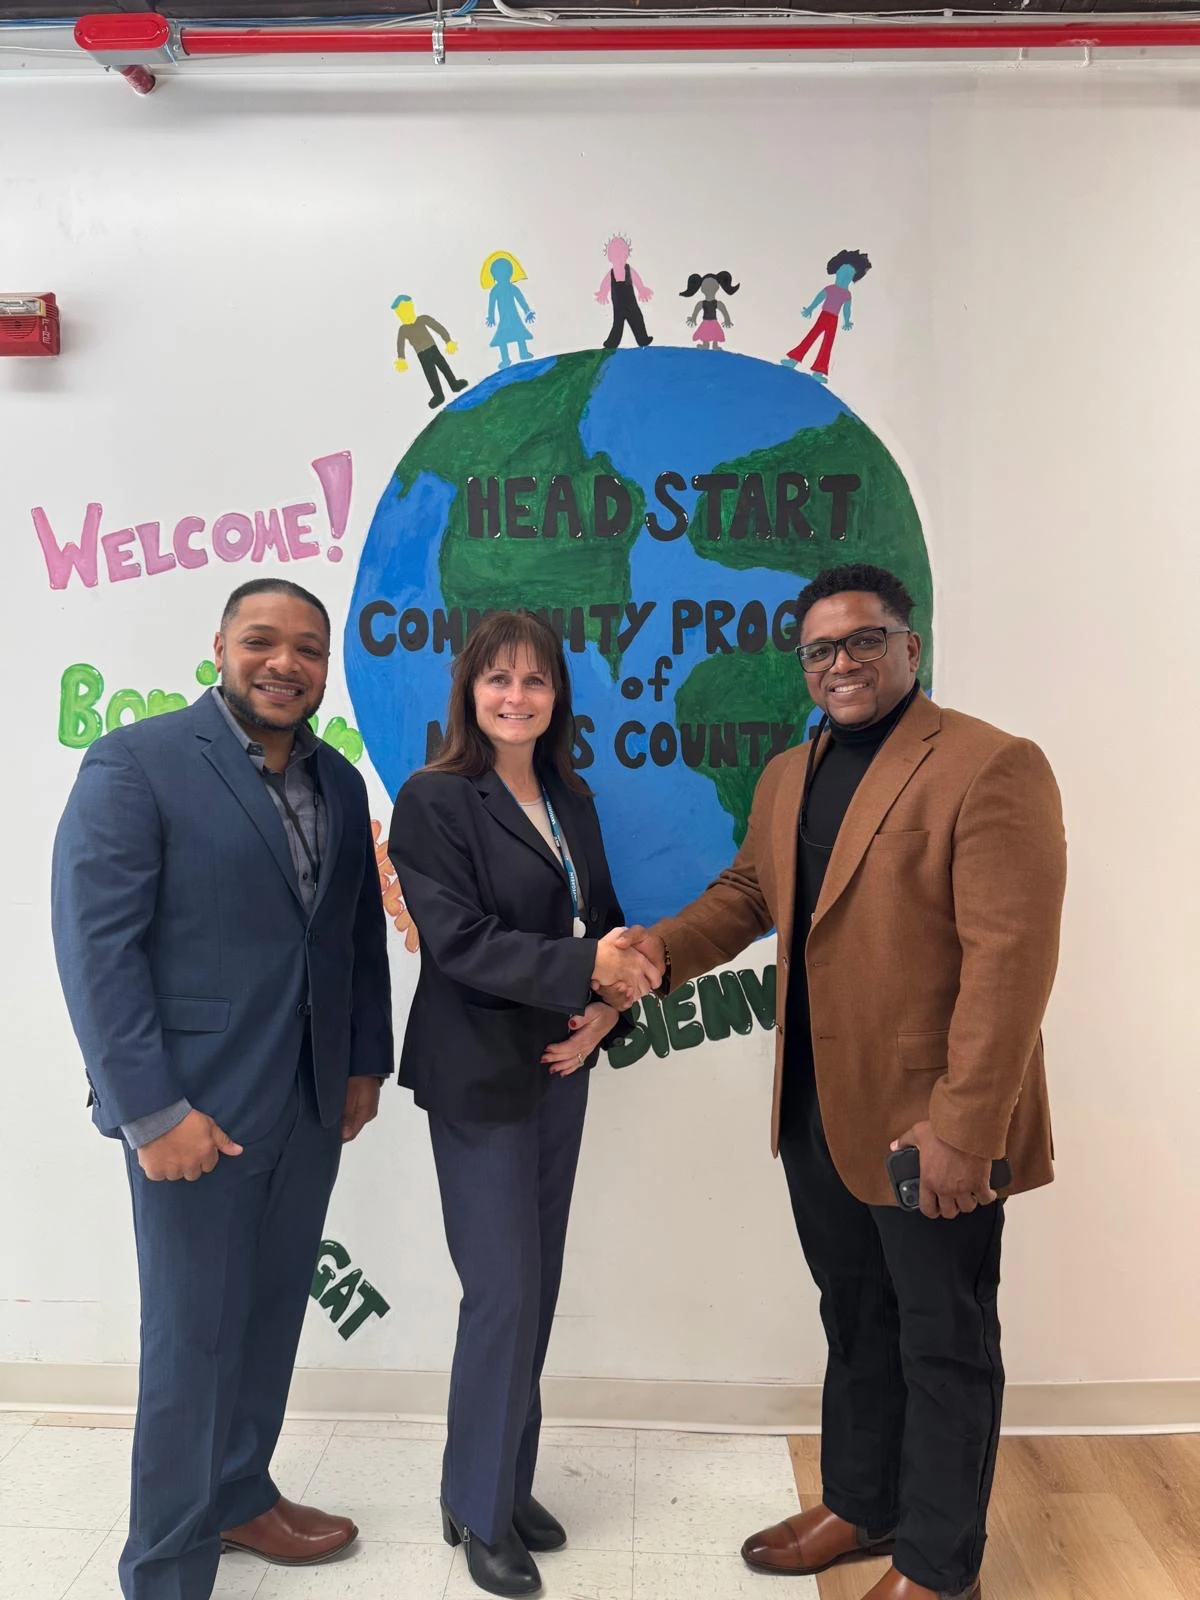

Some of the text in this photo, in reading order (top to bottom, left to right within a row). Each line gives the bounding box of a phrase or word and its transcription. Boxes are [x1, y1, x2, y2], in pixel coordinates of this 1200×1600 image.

[31, 450, 353, 590] WELCOME!
[466, 471, 862, 541] HEAD START
[359, 599, 801, 657] COMITY PROG
[620, 655, 673, 702] of
[614, 720, 797, 769] COUNTY
[309, 1239, 391, 1341] GAT
